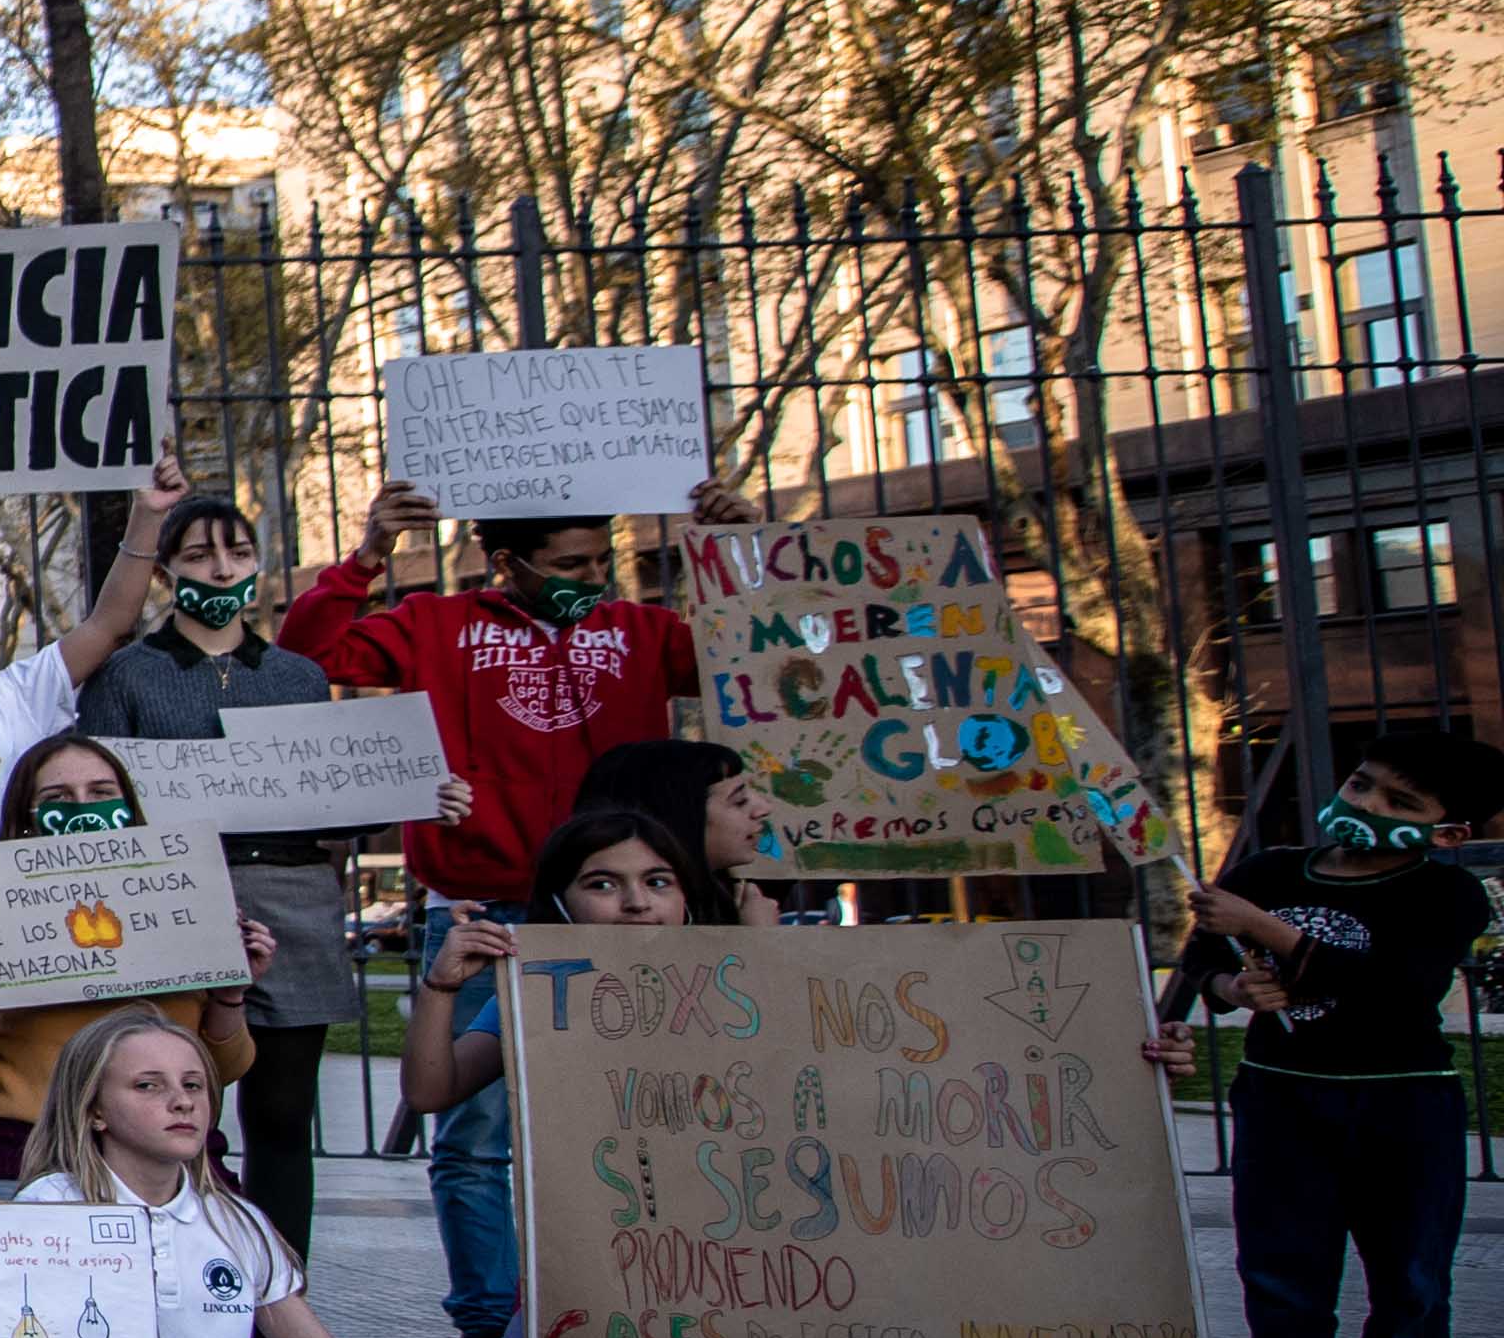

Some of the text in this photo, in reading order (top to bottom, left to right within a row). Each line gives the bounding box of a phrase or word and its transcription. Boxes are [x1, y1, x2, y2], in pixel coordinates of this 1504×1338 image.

[402, 358, 477, 414] CHE
[559, 401, 610, 429] QUE
[457, 620, 532, 649] NEW
[713, 672, 777, 728] EL
[163, 833, 190, 857] ES
[6, 880, 110, 906] PRINCIPAL
[122, 872, 196, 897] CAUSA
[23, 922, 58, 943] LOS
[131, 910, 159, 932] EN
[174, 906, 198, 927] EL
[522, 954, 949, 1064] TODXS NOS
[202, 1301, 253, 1314] LINCOLN
